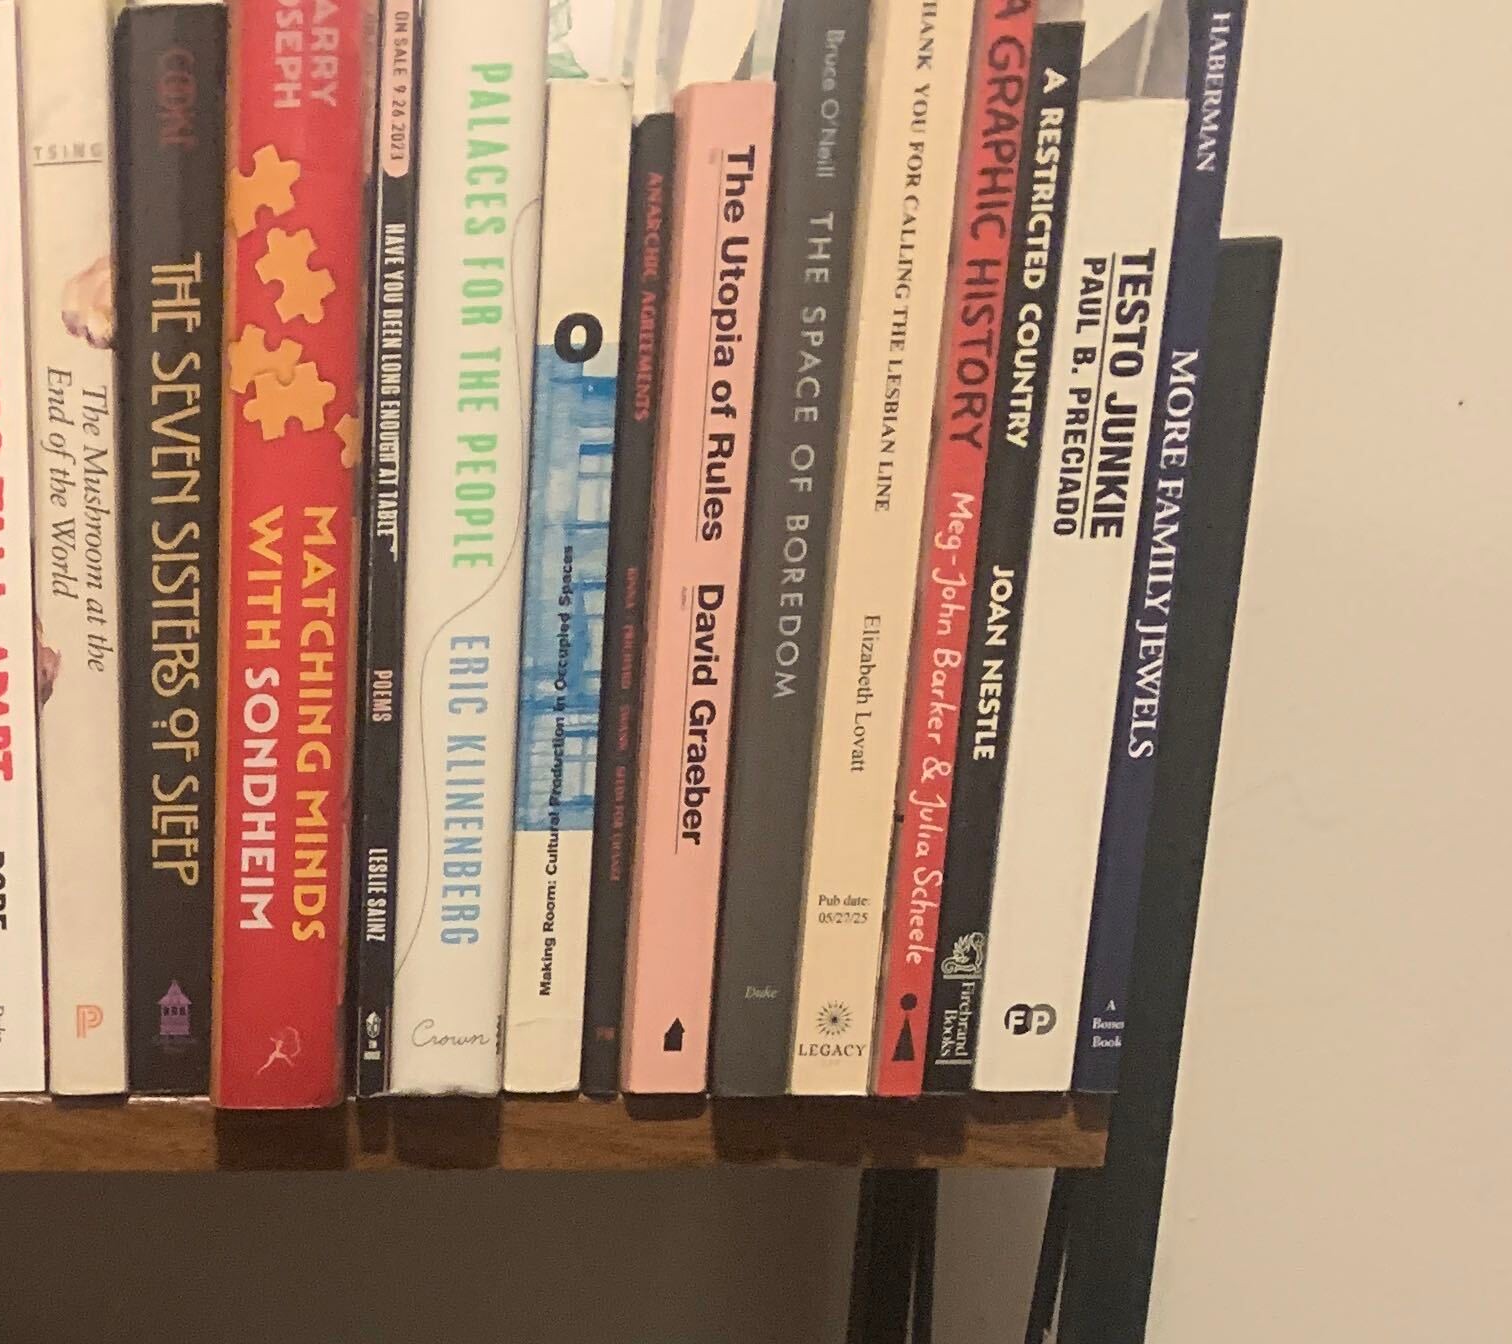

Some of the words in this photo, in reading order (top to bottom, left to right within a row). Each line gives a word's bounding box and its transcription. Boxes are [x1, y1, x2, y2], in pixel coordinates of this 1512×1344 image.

[1043, 67, 1068, 95] A
[1195, 11, 1231, 174] HABERMAN
[462, 62, 513, 237] PALACES
[723, 144, 756, 224] The
[1022, 106, 1066, 291] RESTRICTED
[460, 256, 505, 327] FOR
[712, 234, 751, 368] Utopia
[1074, 256, 1108, 336] PAUL
[1108, 248, 1157, 380] TESTO
[457, 347, 502, 413] THE
[710, 381, 737, 427] of
[1006, 301, 1043, 449] COUNTRY
[1071, 347, 1096, 376] B.
[1162, 347, 1200, 470] MORE
[451, 433, 499, 570] PEOPLE
[700, 431, 737, 544] Rules
[1052, 386, 1093, 538] PRECIADO
[1088, 392, 1136, 540] JUNKIE
[1144, 479, 1185, 617] FAMILY
[690, 584, 725, 687] David
[856, 613, 882, 704] Elizabeth
[984, 565, 1015, 647] JOAN
[371, 669, 393, 723] POEMS
[447, 633, 490, 715] ERIC
[972, 658, 1003, 762] NESTLE
[1127, 617, 1170, 760] JEWELS
[681, 699, 717, 847] Graeber
[849, 710, 873, 774] Lovatt
[439, 733, 487, 948] KLINENBERG
[798, 1042, 866, 1058] LEGACY
